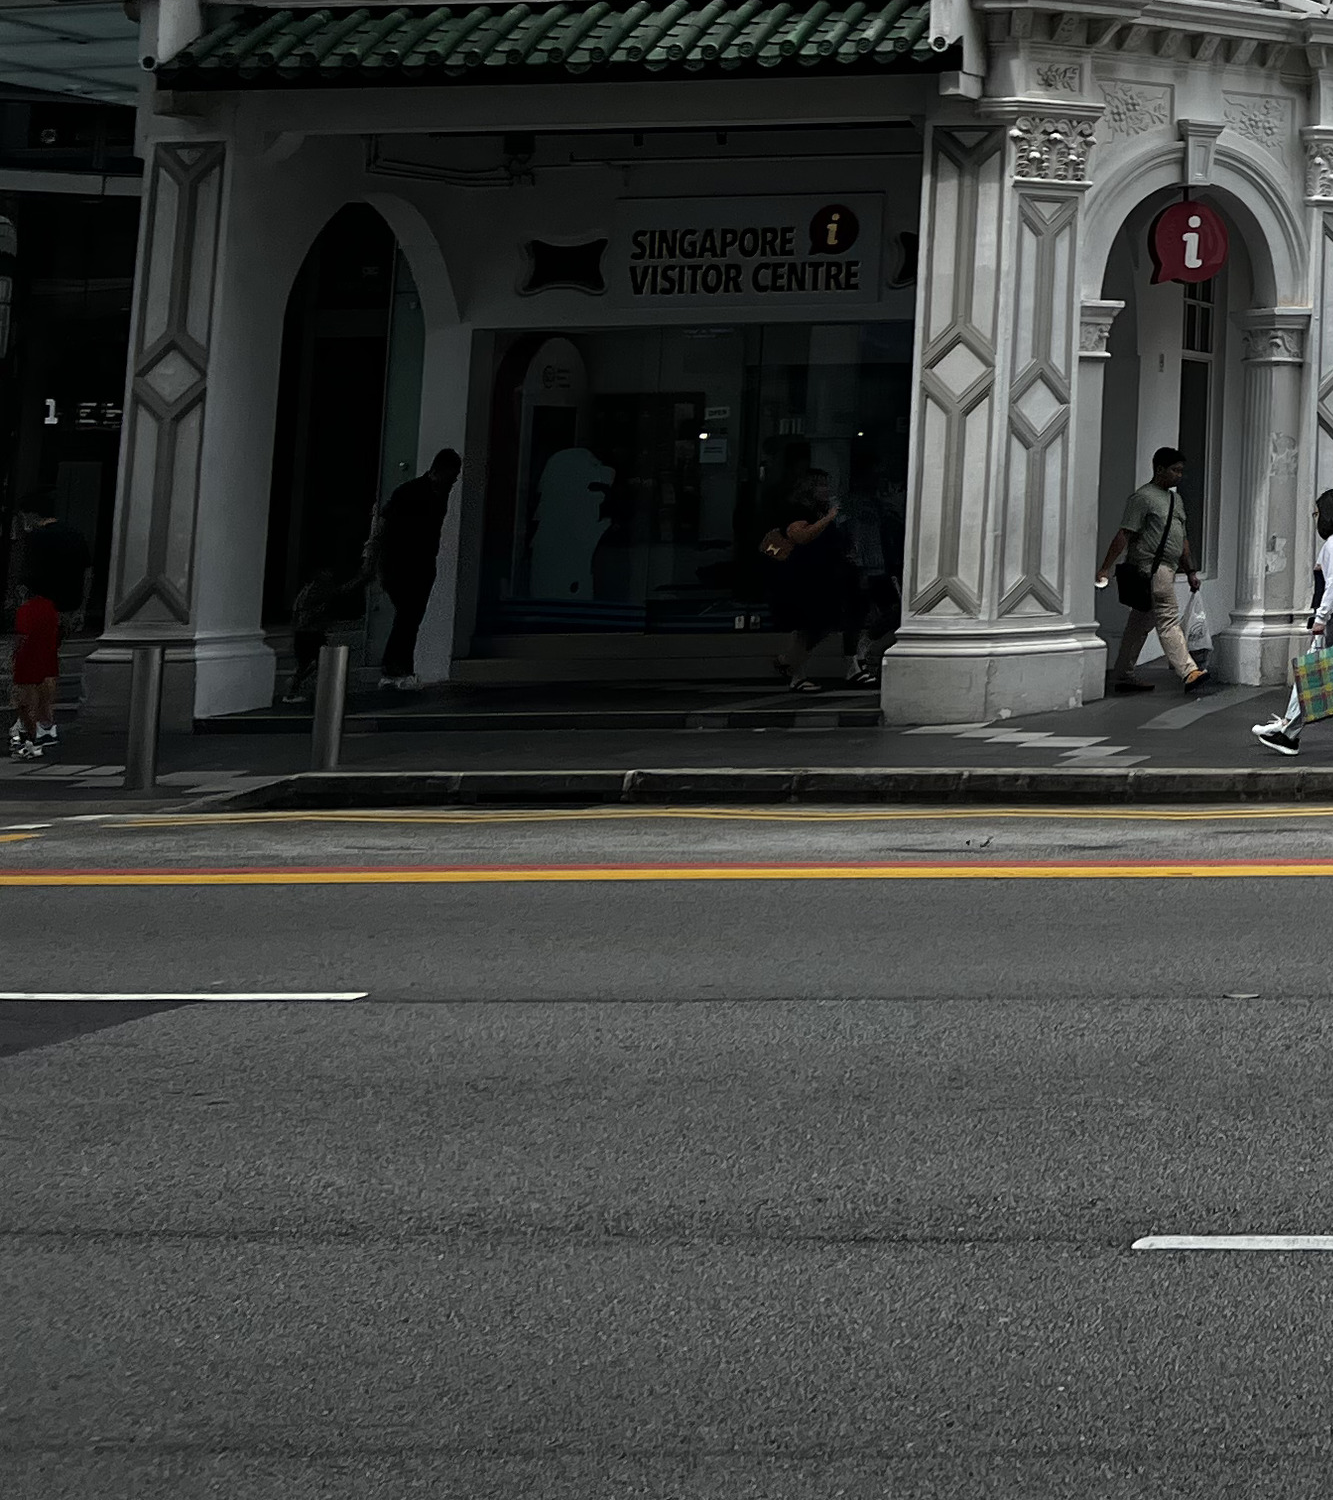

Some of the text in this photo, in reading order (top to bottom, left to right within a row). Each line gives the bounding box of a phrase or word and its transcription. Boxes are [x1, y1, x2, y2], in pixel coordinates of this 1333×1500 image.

[630, 226, 796, 261] SINGAPORE
[629, 260, 862, 296] VISITOR CENTRE
